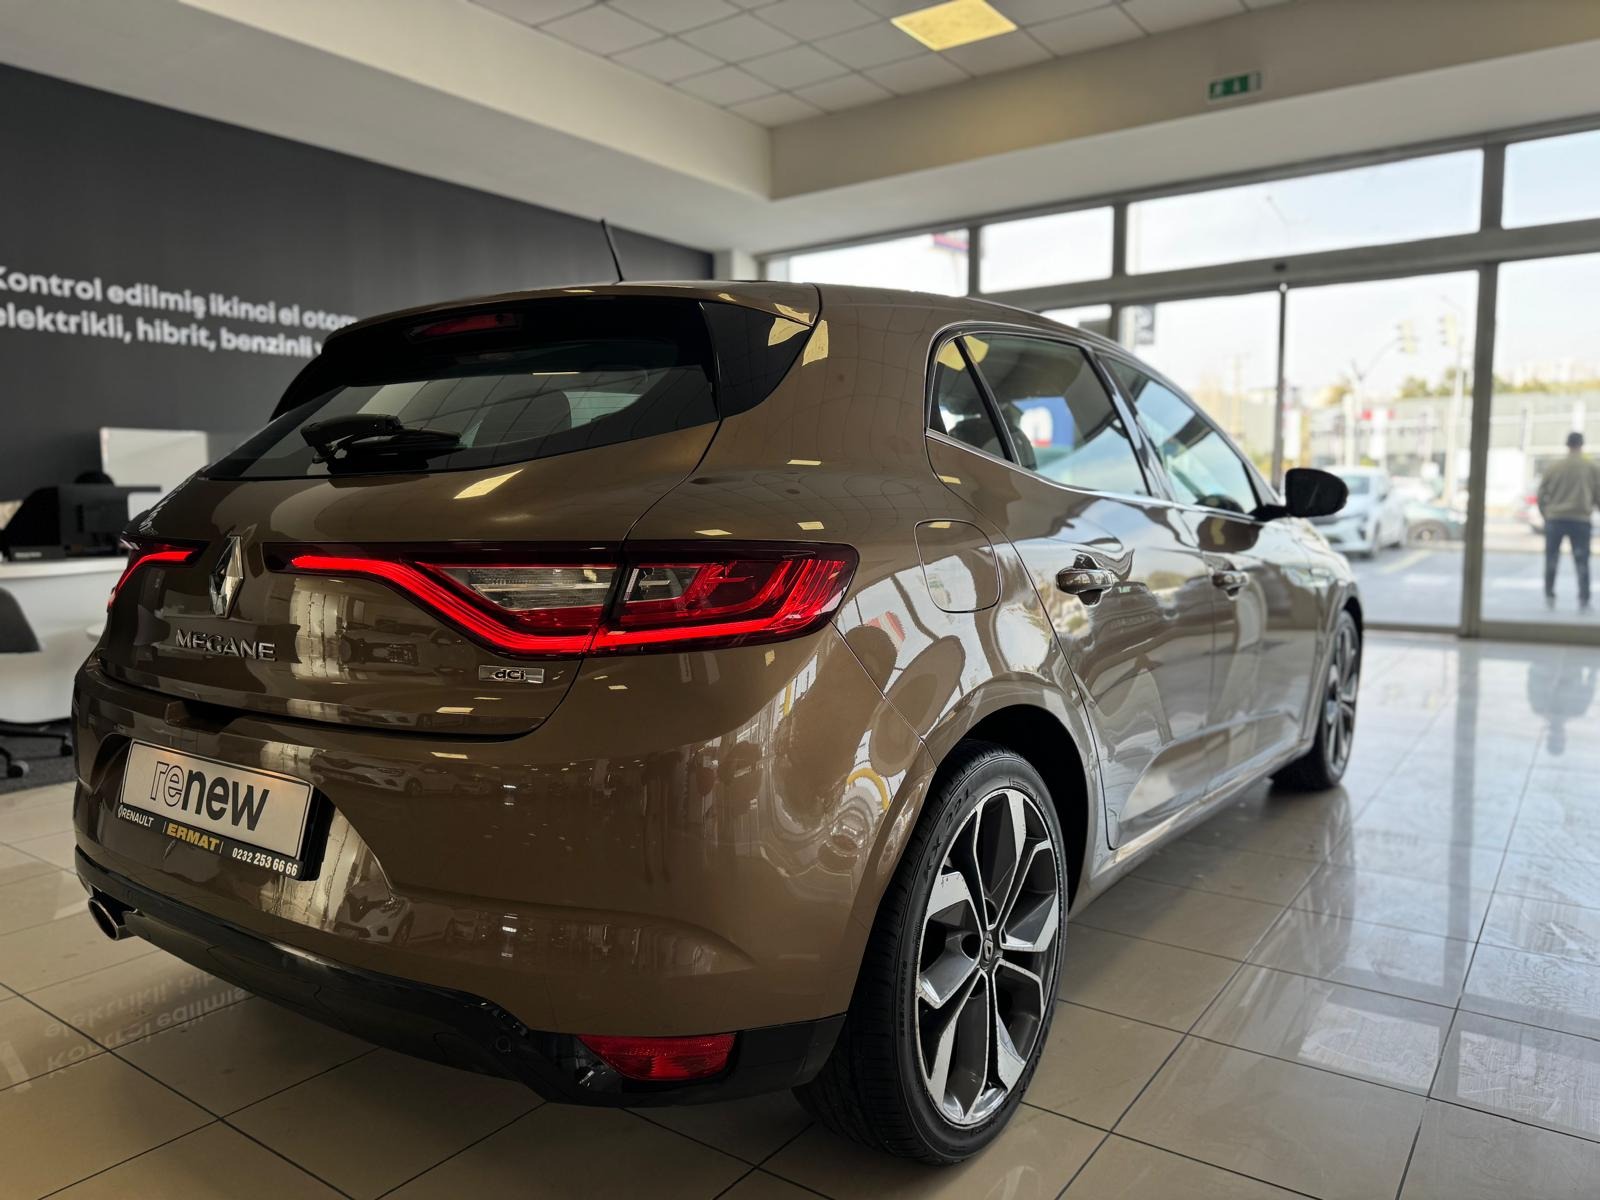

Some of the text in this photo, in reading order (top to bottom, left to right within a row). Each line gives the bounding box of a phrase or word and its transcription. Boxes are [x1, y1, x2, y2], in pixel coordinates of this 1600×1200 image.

[106, 282, 206, 319] edilmiş
[209, 292, 275, 324] ikinci
[279, 303, 300, 327] el
[136, 316, 216, 352] hibrit,
[220, 326, 312, 358] benzinli
[175, 628, 277, 662] MEGANE
[495, 669, 525, 680] dCi
[150, 760, 270, 832] renew
[121, 807, 155, 828] RENAULT
[166, 822, 220, 852] ERMAT
[232, 846, 298, 877] 0232 253 66 66
